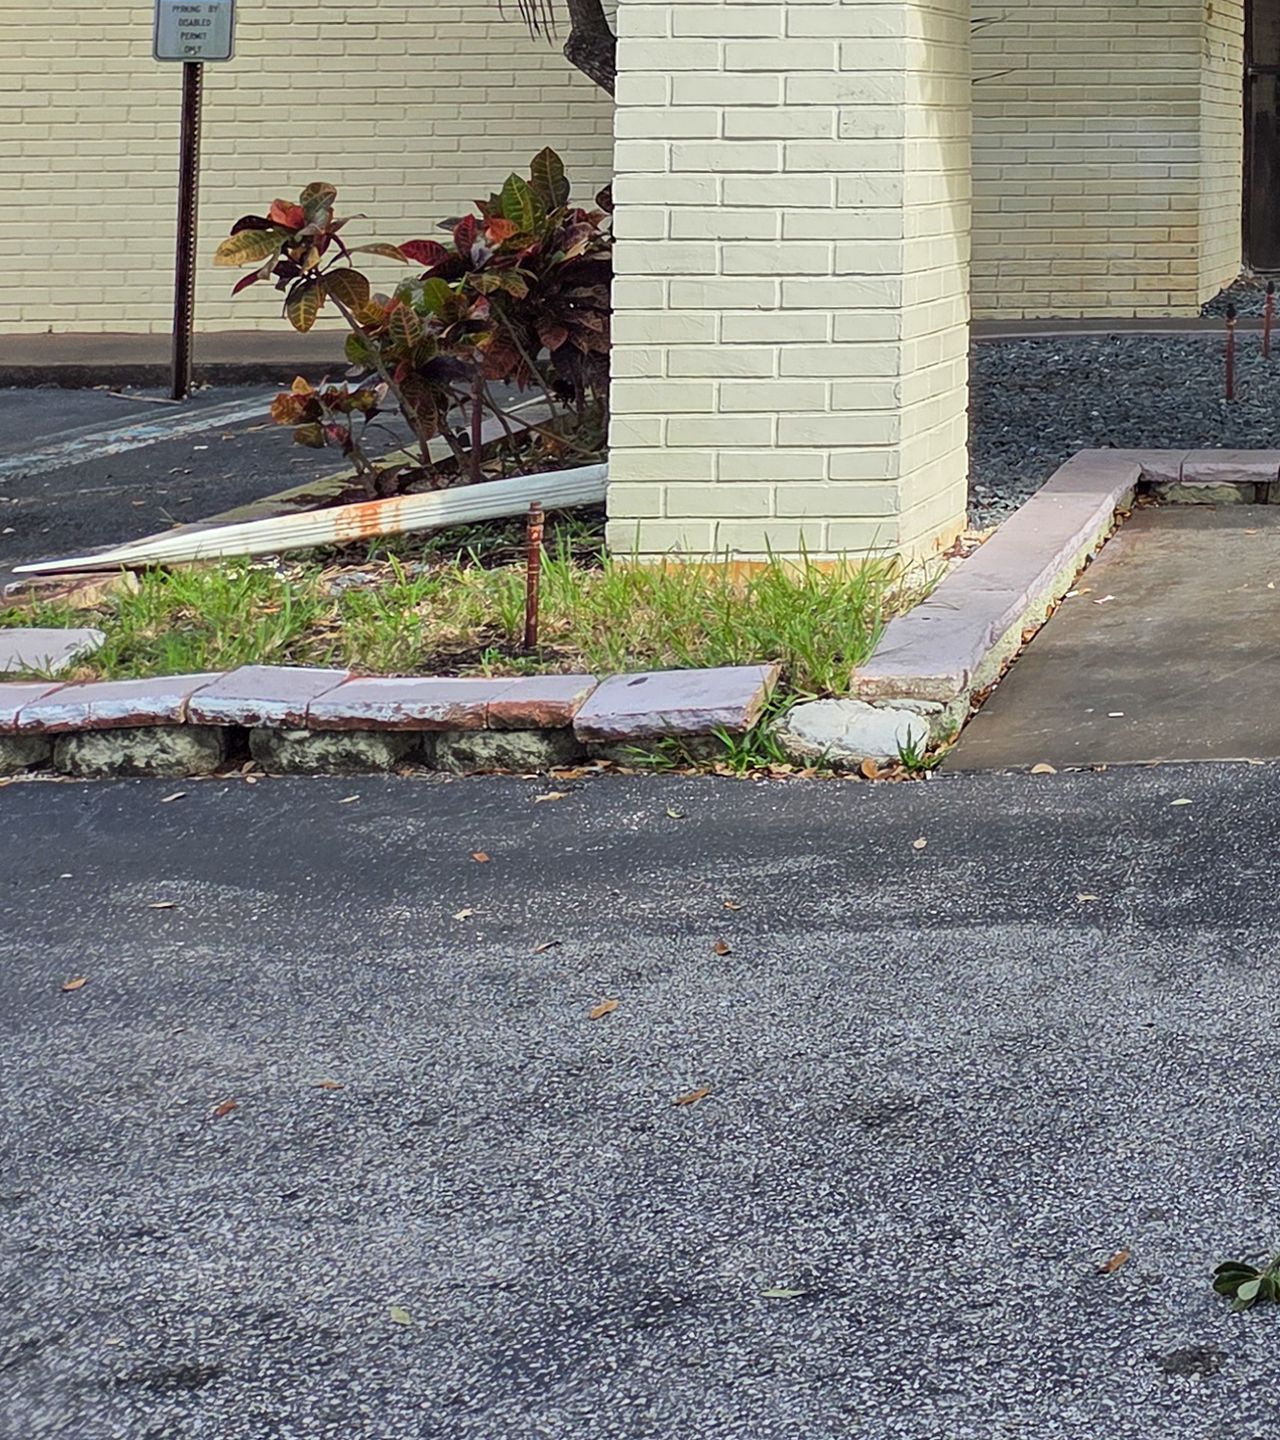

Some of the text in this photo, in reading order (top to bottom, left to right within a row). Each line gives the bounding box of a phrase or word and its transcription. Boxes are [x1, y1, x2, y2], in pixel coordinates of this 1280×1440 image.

[172, 5, 201, 13] PARKING
[178, 18, 212, 27] DISABLED
[180, 32, 207, 40] PERMIT
